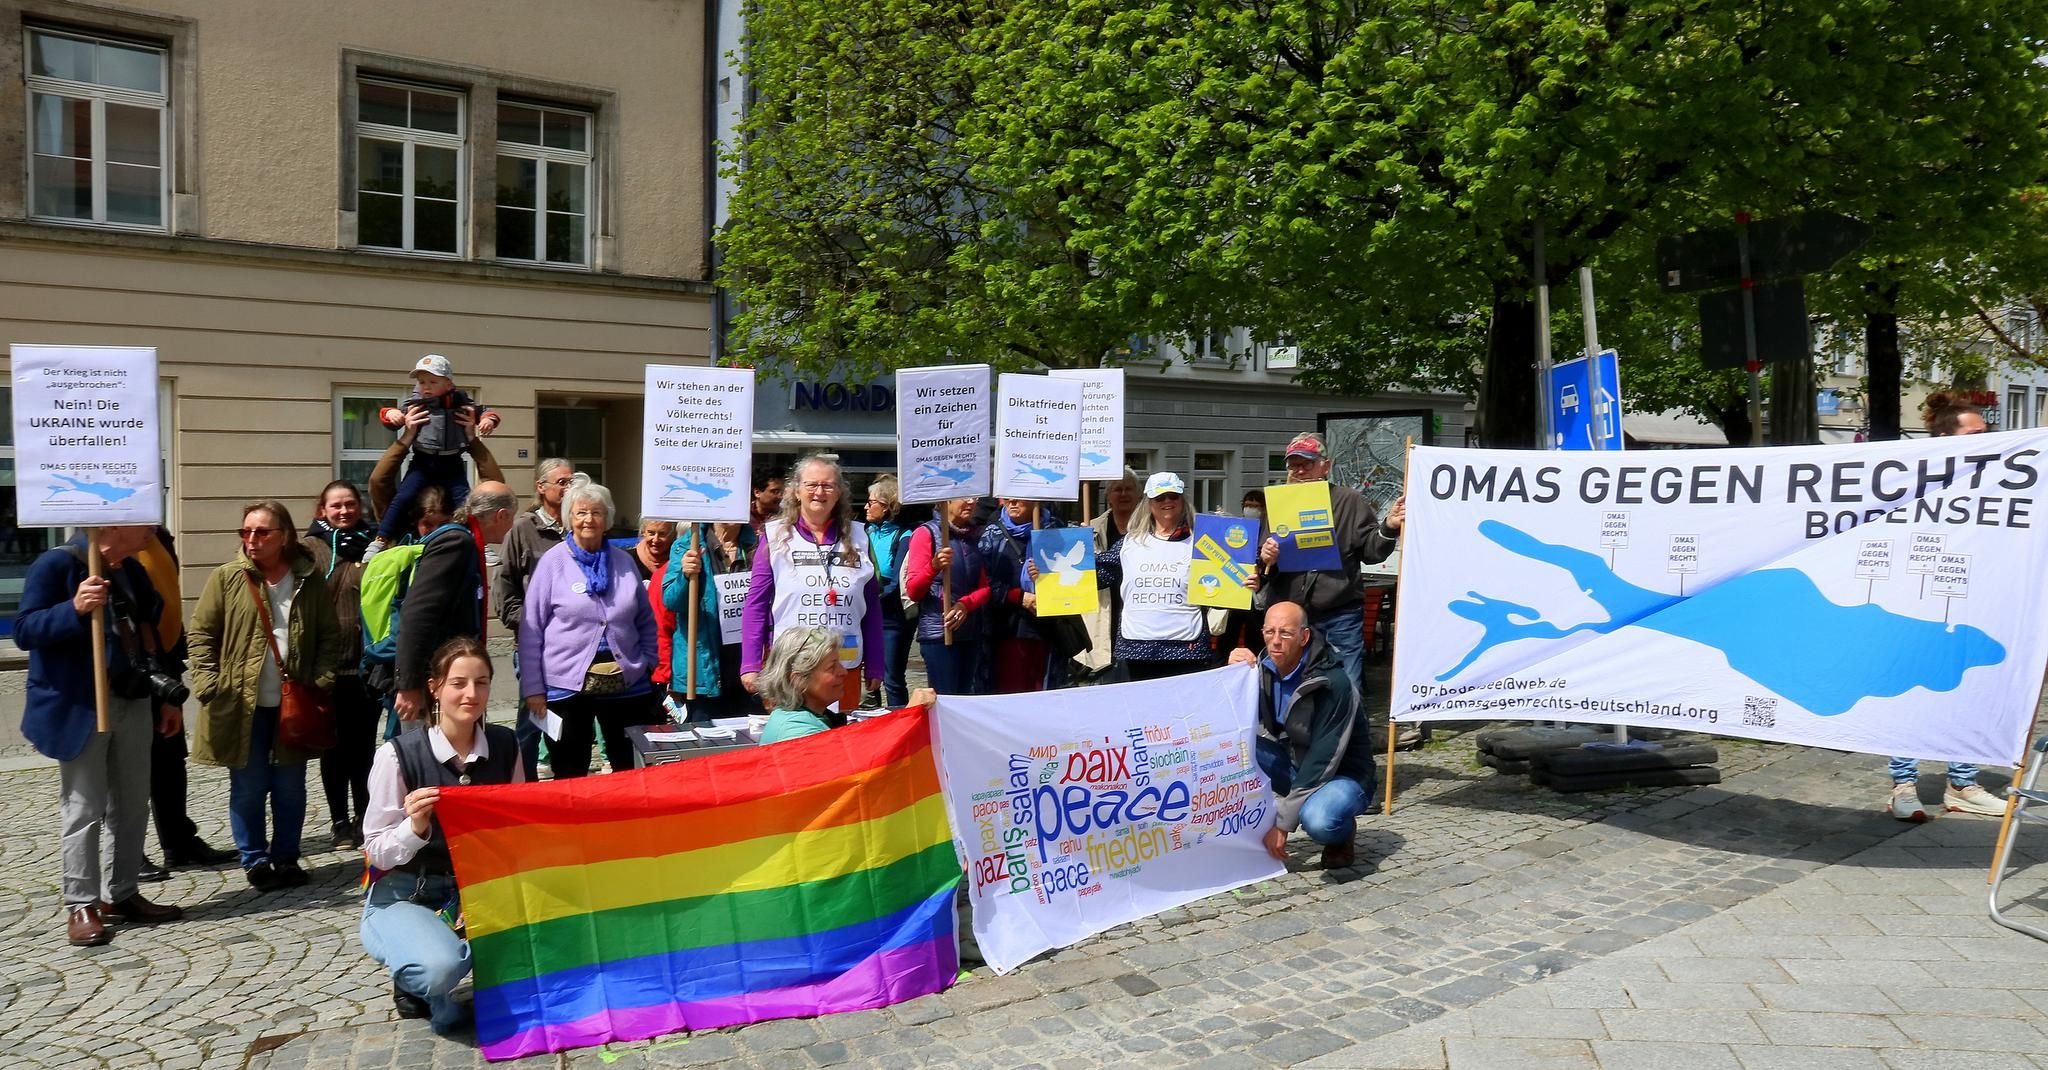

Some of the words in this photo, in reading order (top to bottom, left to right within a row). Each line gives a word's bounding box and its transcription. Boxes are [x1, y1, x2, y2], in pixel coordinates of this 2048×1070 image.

[63, 369, 87, 378] Krieg
[104, 369, 127, 377] nicht
[656, 381, 675, 390] Wir
[677, 382, 710, 392] stehen
[713, 384, 725, 392] an
[728, 384, 744, 393] der
[916, 387, 937, 398] Wir
[940, 386, 975, 397] setzen
[678, 396, 702, 405] Seite
[705, 397, 722, 406] des
[789, 381, 896, 411] NORD
[54, 399, 92, 410] Nein!
[97, 399, 120, 410] Die
[914, 405, 931, 415] ein
[935, 402, 977, 414] Zeichen
[1009, 397, 1077, 411] Diktatfrieden
[666, 409, 733, 421] Völkerrechts!
[1035, 415, 1048, 425] ist
[1100, 415, 1114, 423] den
[30, 417, 95, 428] UKRAINE
[99, 418, 144, 429] wurde
[655, 423, 673, 432] Wir
[676, 424, 709, 434] stehen
[712, 427, 723, 435] an
[727, 426, 743, 435] der
[938, 420, 954, 430] für
[49, 435, 127, 446] überfallen!
[1005, 428, 1078, 441] Scheinfrieden!
[654, 438, 679, 447] Seite
[681, 439, 698, 448] der
[701, 440, 743, 450] Ukraine!
[911, 433, 980, 449] Demokratie!
[660, 464, 681, 472] OMAS
[1429, 464, 1562, 504] OMAS
[1579, 464, 1764, 504] GEGEN
[1787, 449, 2041, 503] RECHTS
[1916, 535, 1941, 543] OMAS
[1671, 545, 1696, 553] GEGEN
[1861, 550, 1889, 558] GEGEN
[1913, 545, 1942, 553] GEGEN
[1670, 554, 1697, 562] RECHTS
[1857, 559, 1890, 567] RECHTS
[1941, 555, 1966, 564] OMAS
[1139, 563, 1178, 573] OMAS
[1937, 565, 1967, 574] GEGEN
[724, 578, 752, 590] OMAS
[805, 575, 850, 588] OMAS
[1134, 577, 1181, 588] GEGEN
[1934, 575, 1968, 585] RECHTS
[1132, 593, 1183, 605] RECHTS
[798, 613, 853, 626] RECHTS
[1029, 745, 1058, 761] мир
[1124, 727, 1150, 787] shanti
[1059, 736, 1131, 785] paix
[1005, 754, 1034, 825] salam
[1191, 782, 1240, 813] shalom
[972, 801, 999, 822] paco
[1191, 797, 1244, 825] tangnefedd
[1032, 780, 1190, 864] peace
[1216, 800, 1267, 838] pokój
[979, 816, 1000, 854] pax
[1086, 824, 1169, 875] frieden
[1003, 827, 1031, 895] barış
[975, 853, 1010, 898] paz
[1042, 862, 1089, 904] pace
